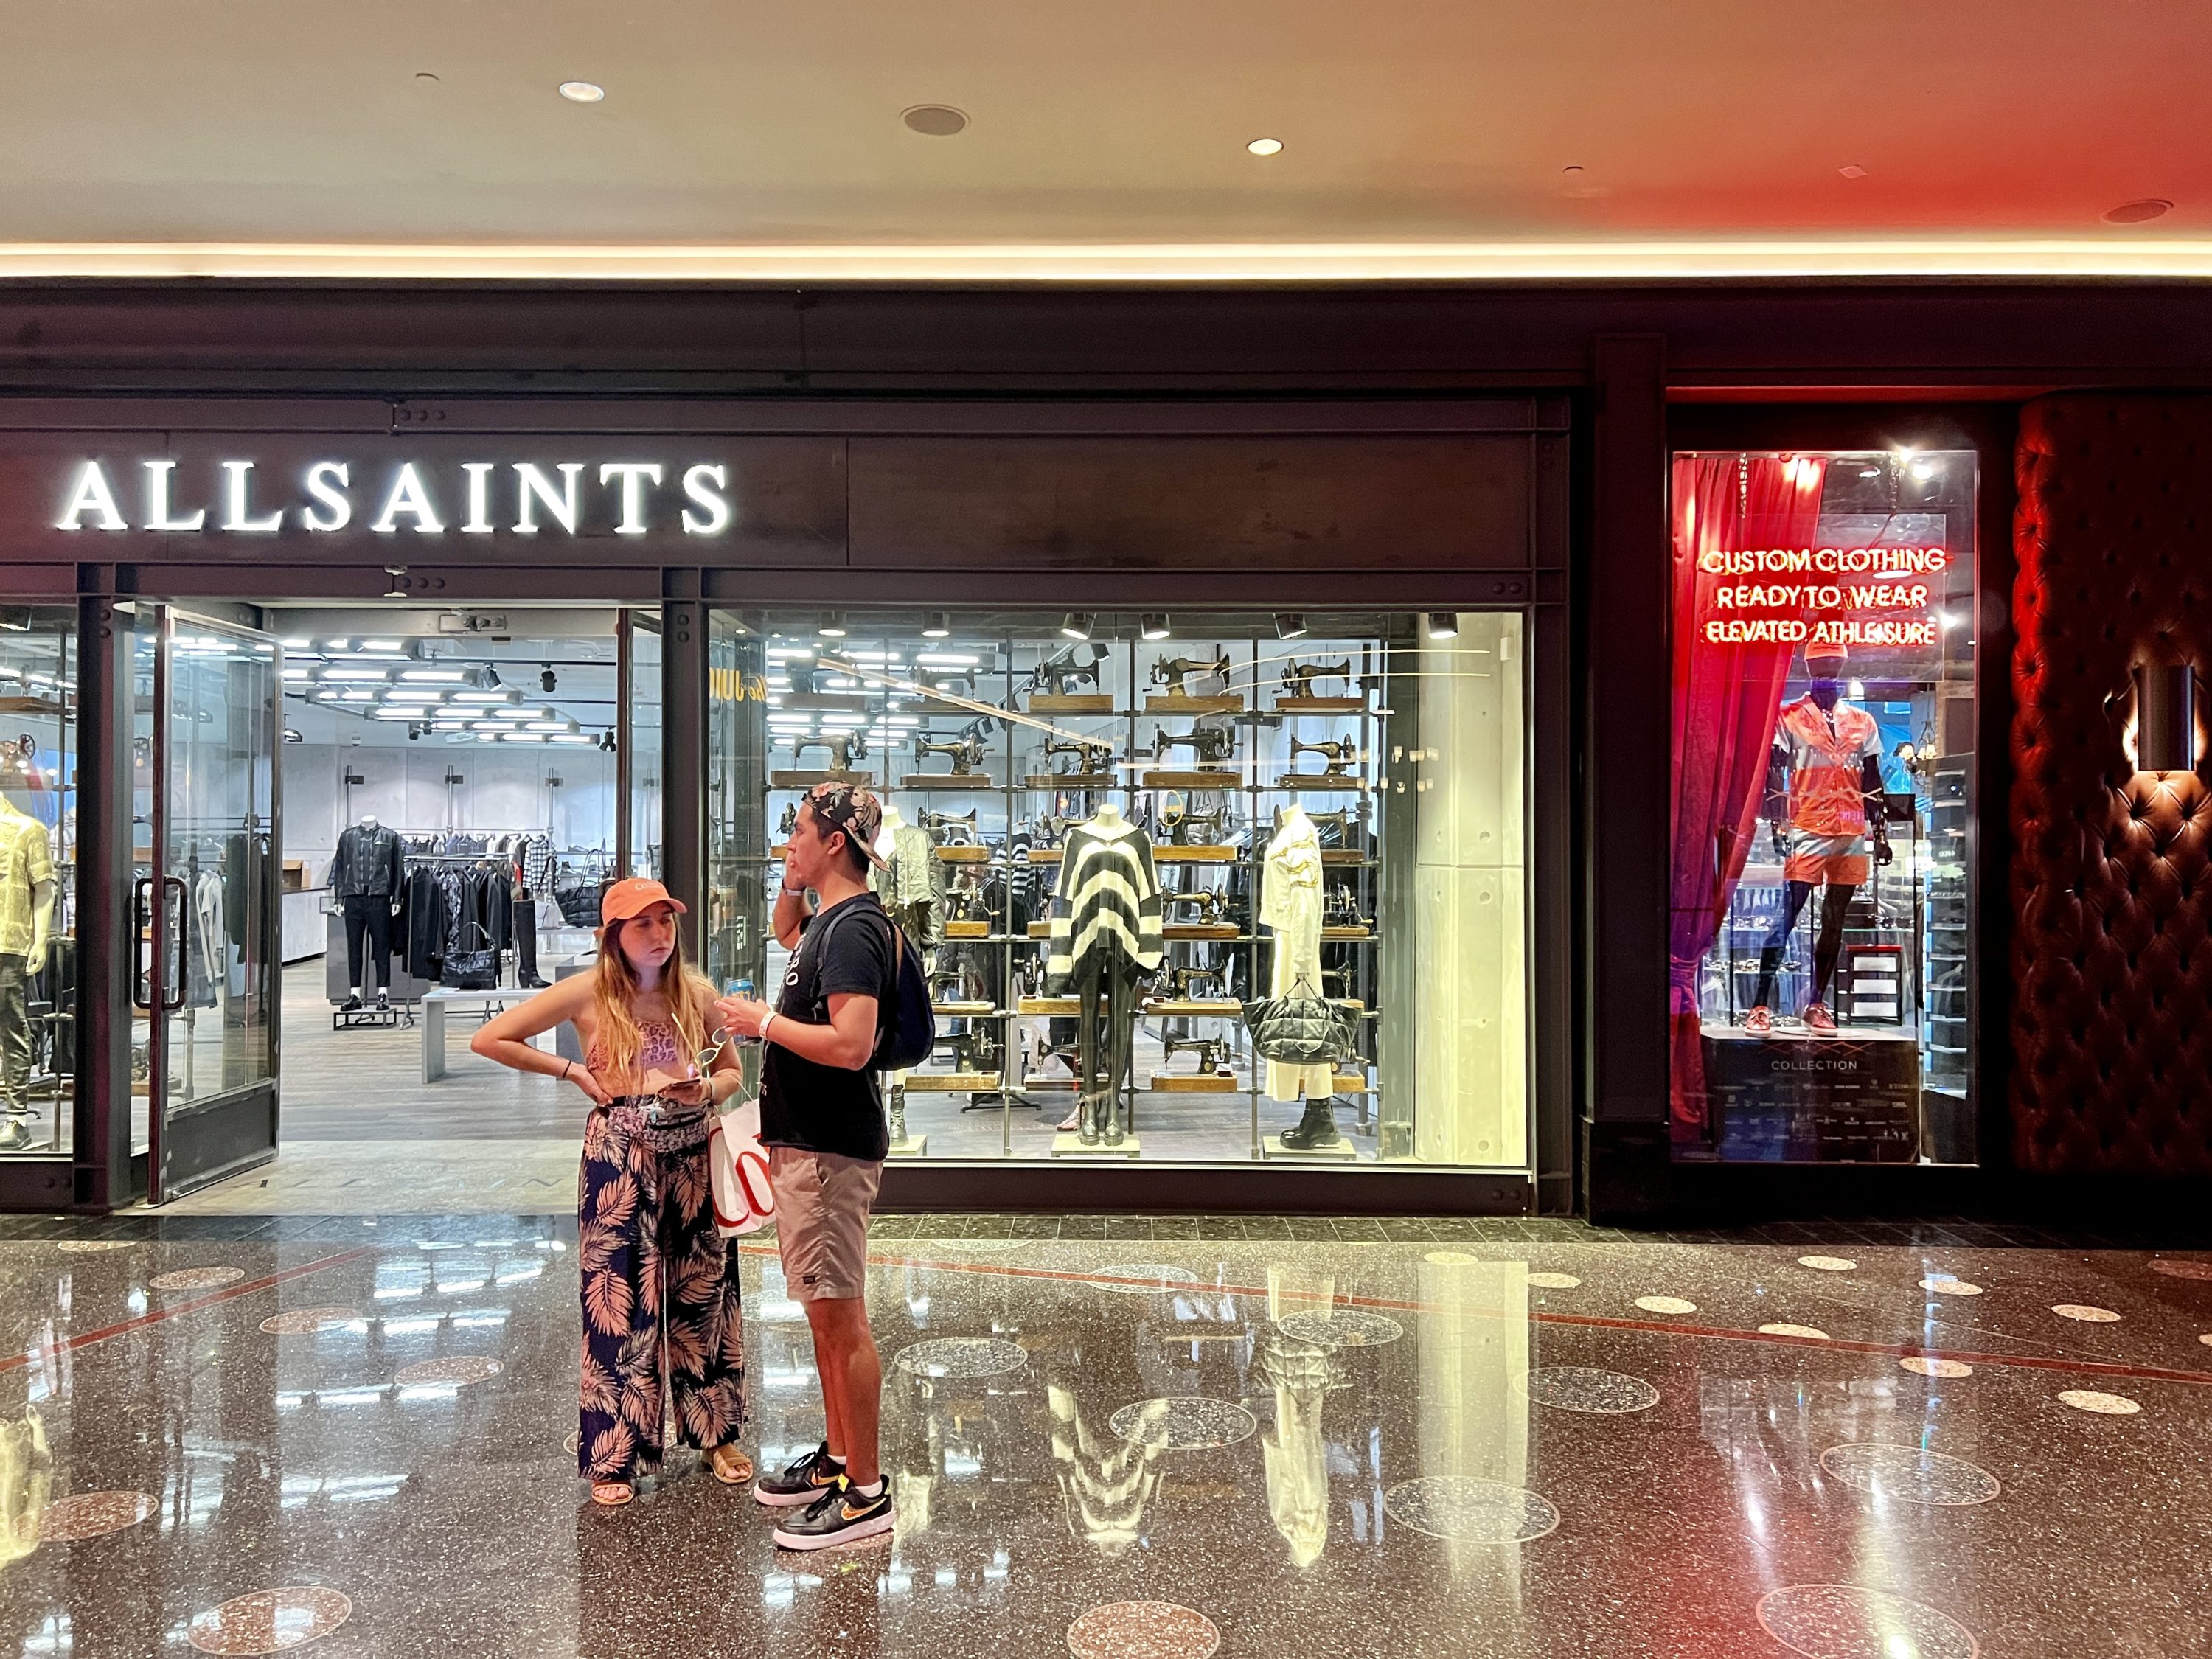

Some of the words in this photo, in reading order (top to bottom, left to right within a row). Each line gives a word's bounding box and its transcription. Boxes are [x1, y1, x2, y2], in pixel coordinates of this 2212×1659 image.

[55, 459, 730, 536] ALLSAINTS
[1703, 549, 1811, 573] CUSTOM
[1815, 548, 1947, 571] CLOTHING
[1717, 585, 1801, 608] READY
[1804, 585, 1841, 608] TO
[1850, 585, 1928, 609] WEAR
[1705, 619, 1807, 643] ELEVATED
[1812, 621, 1936, 644] ATHLEISURE
[1770, 1060, 1857, 1071] COLLECTION
